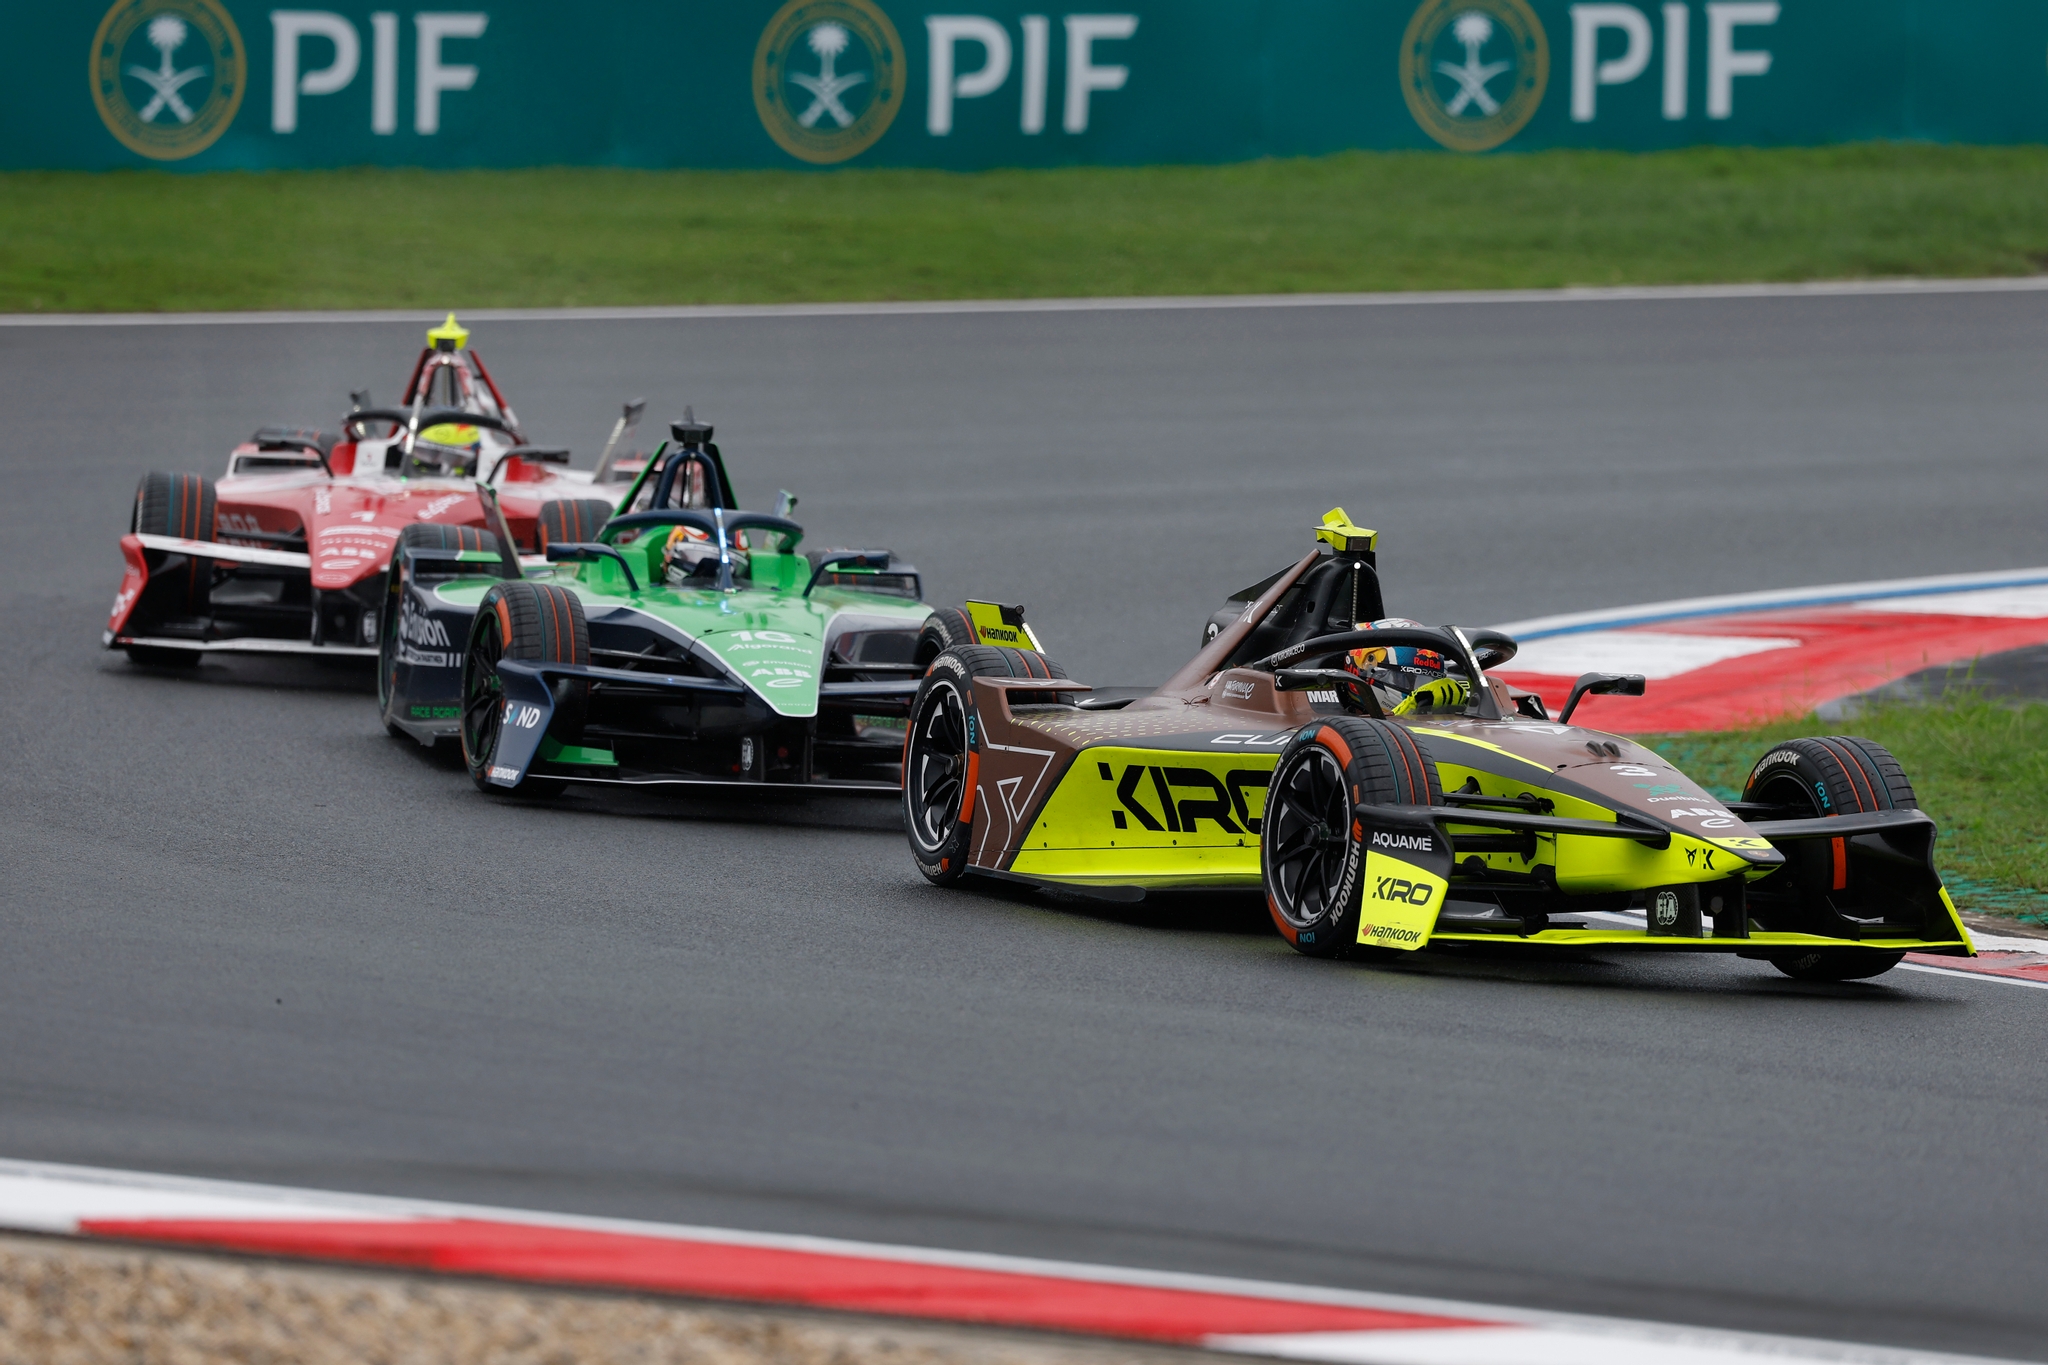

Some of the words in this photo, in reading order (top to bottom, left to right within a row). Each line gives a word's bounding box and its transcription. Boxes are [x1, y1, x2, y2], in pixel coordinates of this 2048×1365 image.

[1570, 1, 1782, 122] PIF
[270, 9, 490, 135] PIF
[925, 14, 1140, 136] PIF
[727, 643, 812, 655] Algorand
[751, 667, 812, 679] ABB
[1413, 656, 1429, 667] Red
[1430, 660, 1441, 670] Bull
[1610, 765, 1657, 777] 3
[1372, 831, 1432, 851] AQUAME
[1371, 876, 1433, 906] KIRO
